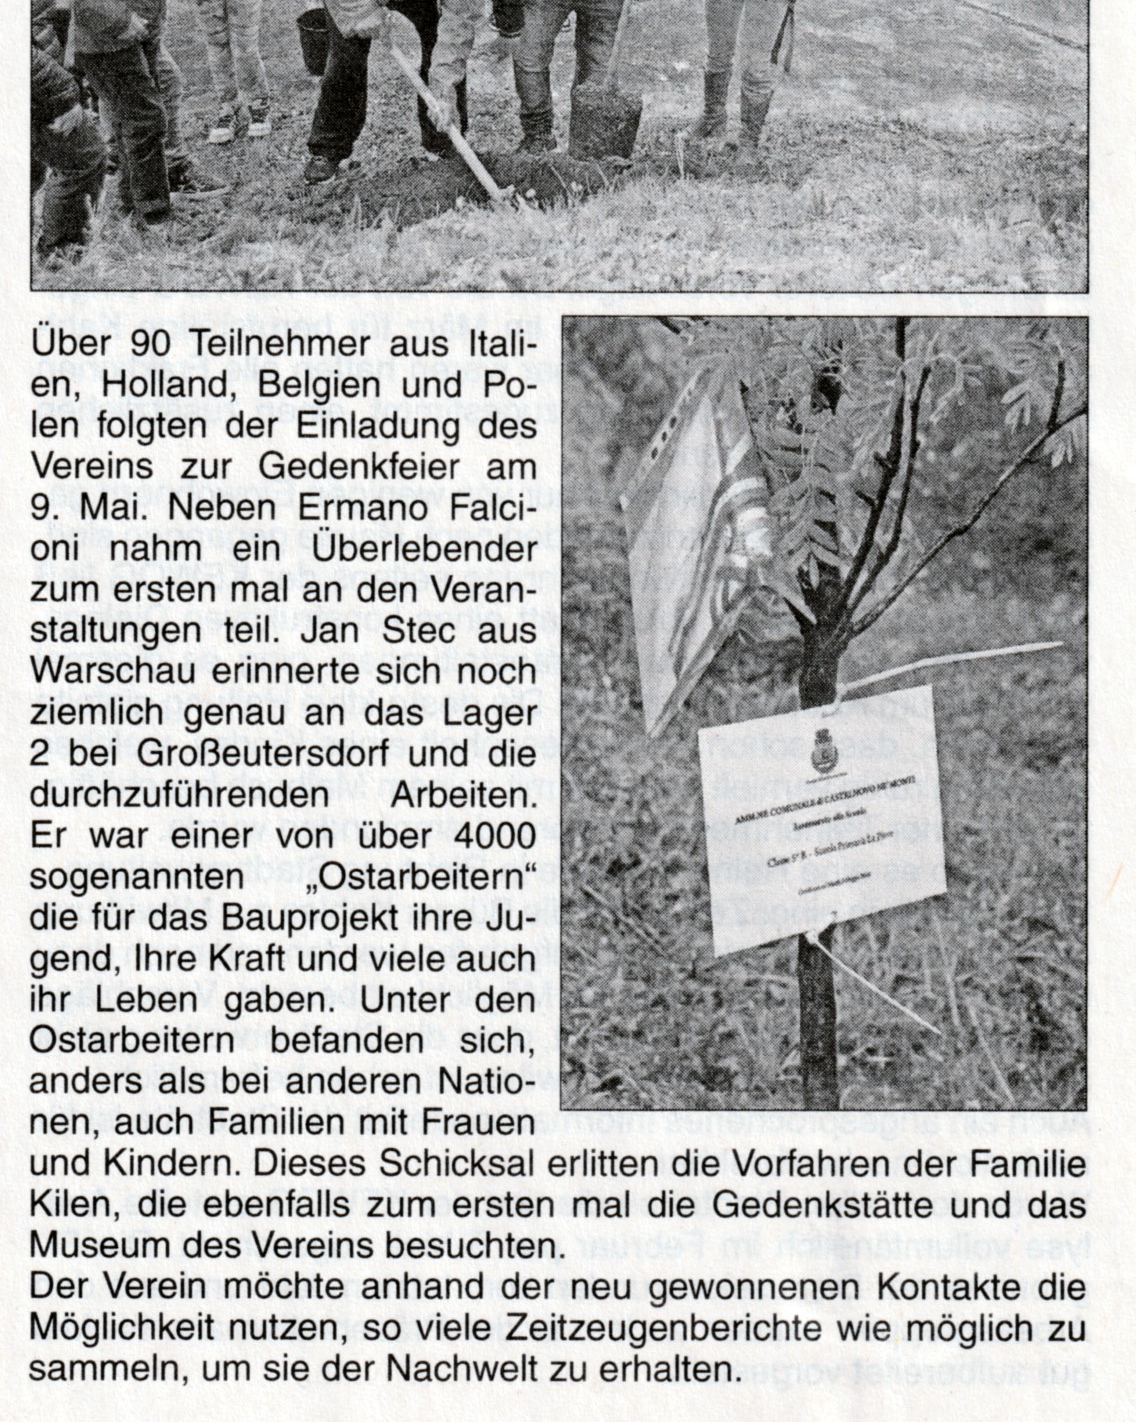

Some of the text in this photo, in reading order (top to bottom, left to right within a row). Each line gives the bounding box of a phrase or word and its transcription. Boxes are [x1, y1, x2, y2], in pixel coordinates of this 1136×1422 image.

[32, 320, 537, 358] Über 90 Teilnehmer aus Itali-
[31, 409, 538, 447] len folgten der Einladung des
[30, 491, 537, 522] 9. Mai. Neben Ermano Falci-
[30, 574, 537, 604] zum ersten mal an den Veran-
[29, 654, 536, 685] Warschau erinnerte sich noch
[30, 778, 537, 809] durchzuführenden Arbeiten.
[29, 863, 244, 898] sogenannten
[29, 942, 536, 980] gend, Ihre Kraft und viele auch
[29, 1023, 534, 1059] Ostarbeitern befanden sich,
[30, 1106, 535, 1140] nen, auch Familien mit Frauen
[30, 1229, 565, 1260] Museum des Vereins besuchten.
[30, 1270, 1086, 1308] Der Verein möchte anhand der neu gewonnenen Kontakte die
[28, 1352, 742, 1386] sammeln, um sie der Nachwelt zu erhalten.
